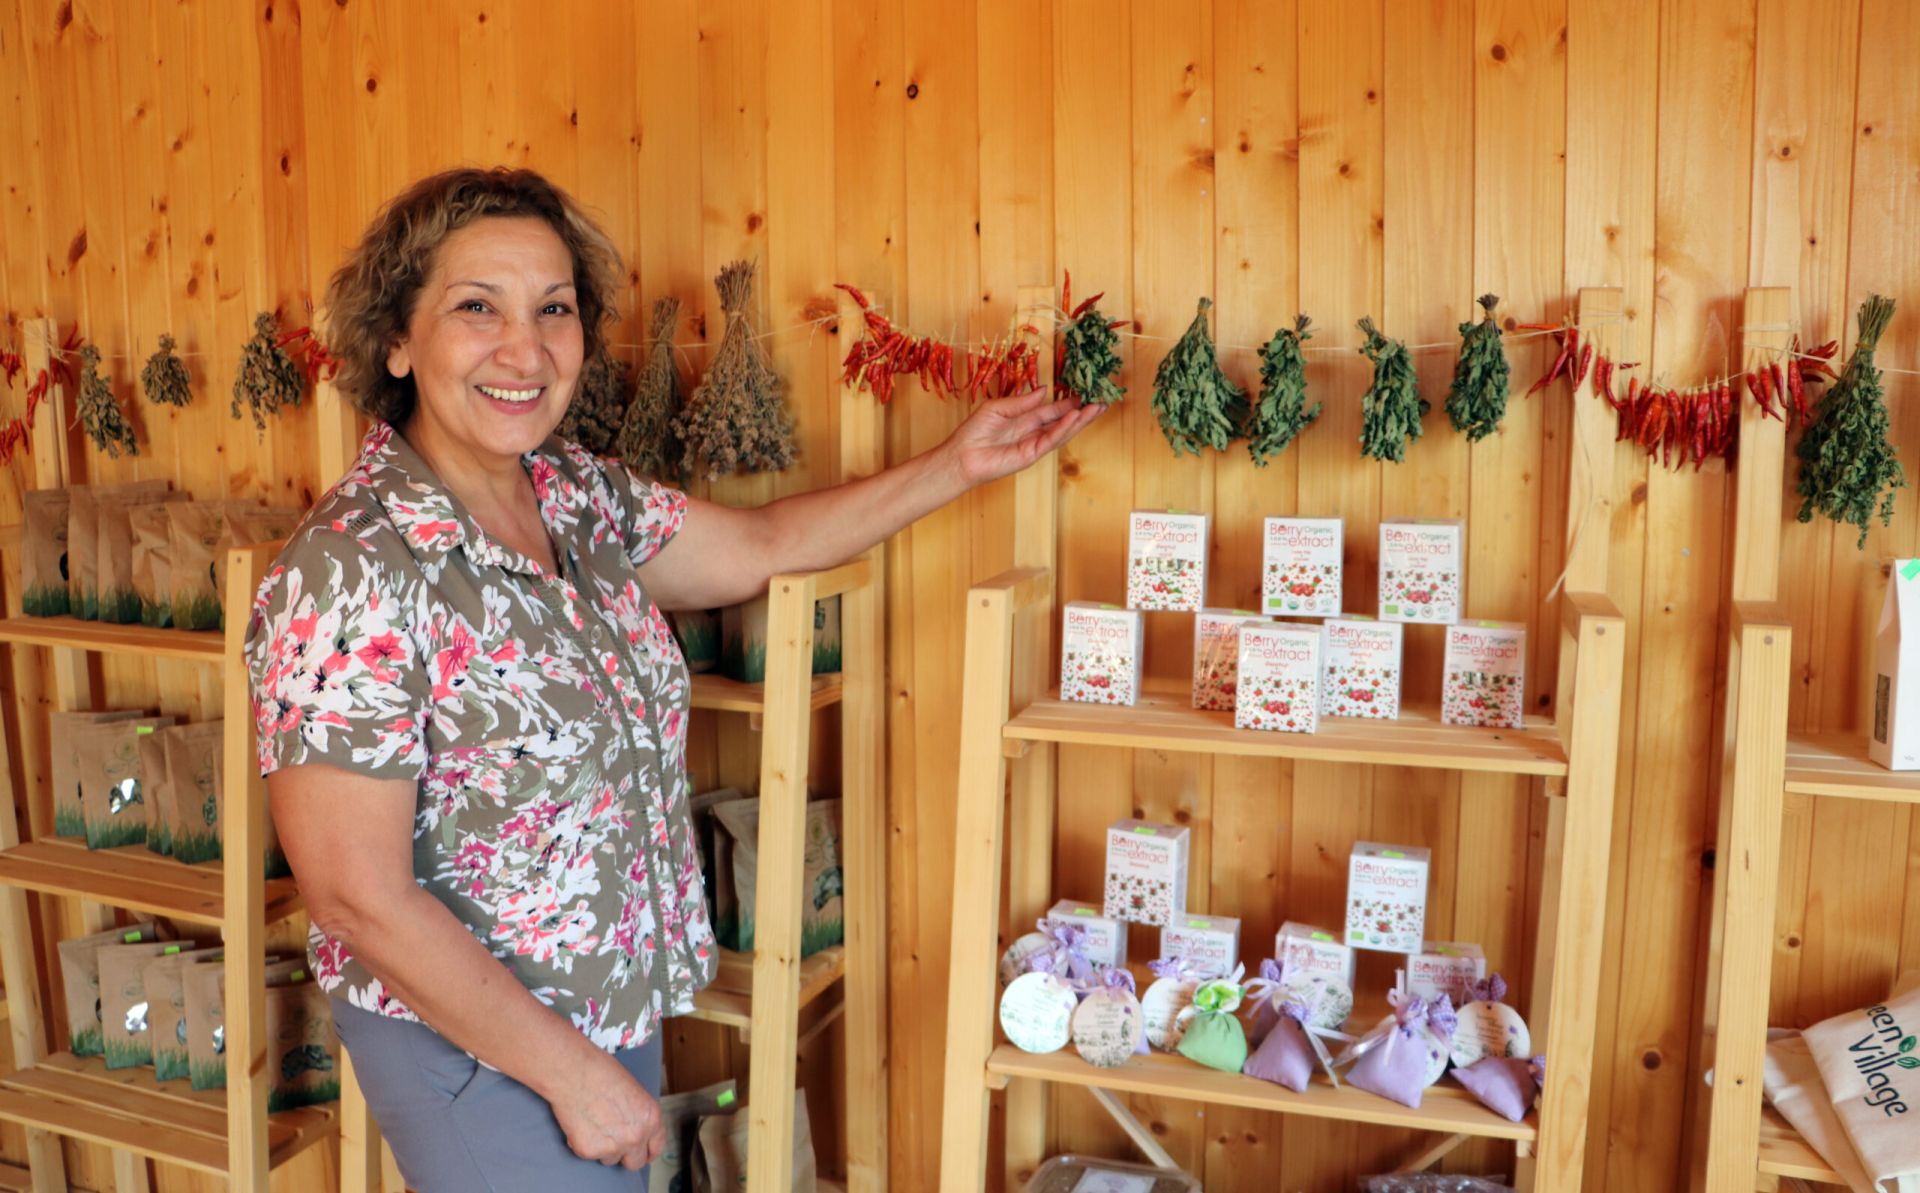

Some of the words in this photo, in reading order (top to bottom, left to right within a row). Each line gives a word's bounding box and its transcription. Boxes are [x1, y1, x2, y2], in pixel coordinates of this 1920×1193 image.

[1135, 517, 1168, 532] Berry
[1270, 523, 1303, 538] Berry
[1153, 529, 1198, 544] extract
[1288, 535, 1335, 548] extract
[1385, 528, 1418, 544] Berry
[1069, 611, 1100, 628] Berry
[1201, 619, 1233, 635] Berry
[1329, 624, 1362, 640] Berry
[1452, 631, 1487, 647] Berry
[1244, 632, 1279, 649] Berry
[1280, 637, 1310, 647] Organic
[1347, 639, 1394, 652] extract
[1263, 648, 1311, 661] extract
[1471, 646, 1518, 659] extract
[1111, 833, 1143, 850] Berry
[1127, 849, 1169, 865] extract
[1355, 860, 1388, 876] Berry
[1373, 875, 1418, 889] extract
[1414, 960, 1447, 976] Berry
[1866, 1004, 1904, 1043] een
[1848, 1033, 1909, 1118] Village
